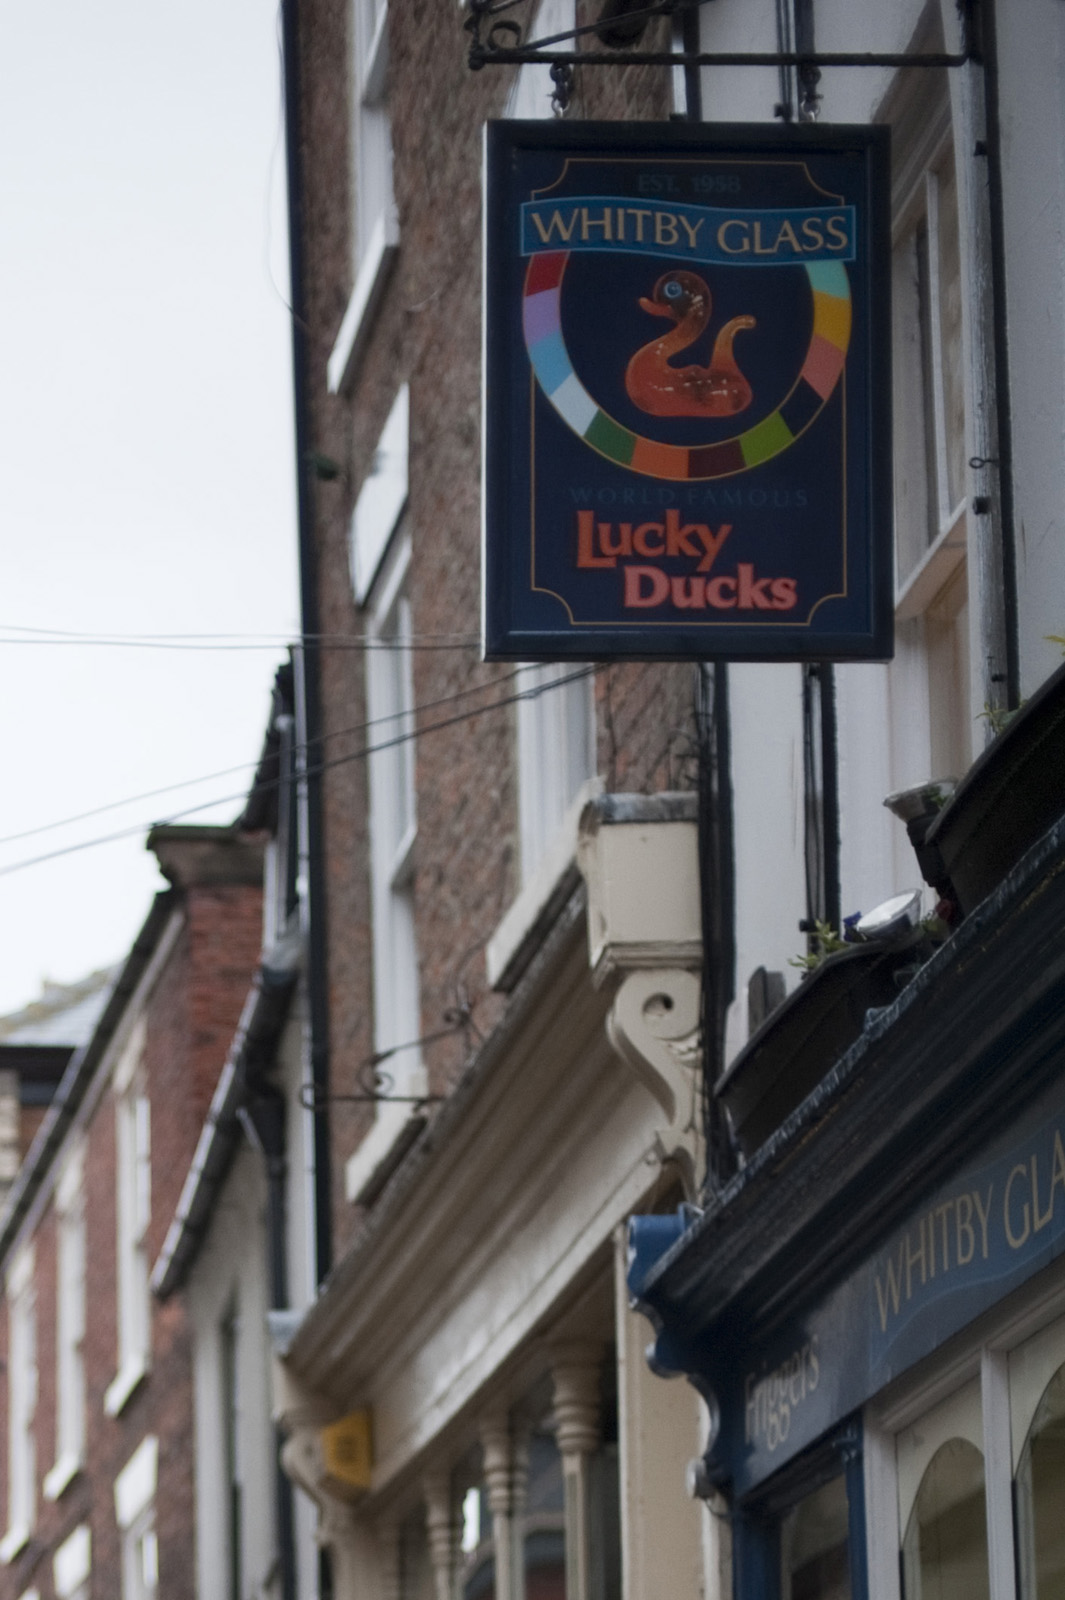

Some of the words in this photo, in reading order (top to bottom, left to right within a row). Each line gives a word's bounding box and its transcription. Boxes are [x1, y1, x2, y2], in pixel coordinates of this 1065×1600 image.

[531, 208, 706, 250] WHITBY
[717, 215, 848, 255] GLASS
[570, 487, 676, 505] WORLD
[687, 488, 809, 507] FAMOUS
[576, 508, 733, 572] Lucky
[623, 563, 799, 610] Ducks
[875, 1184, 994, 1333] WHITBY
